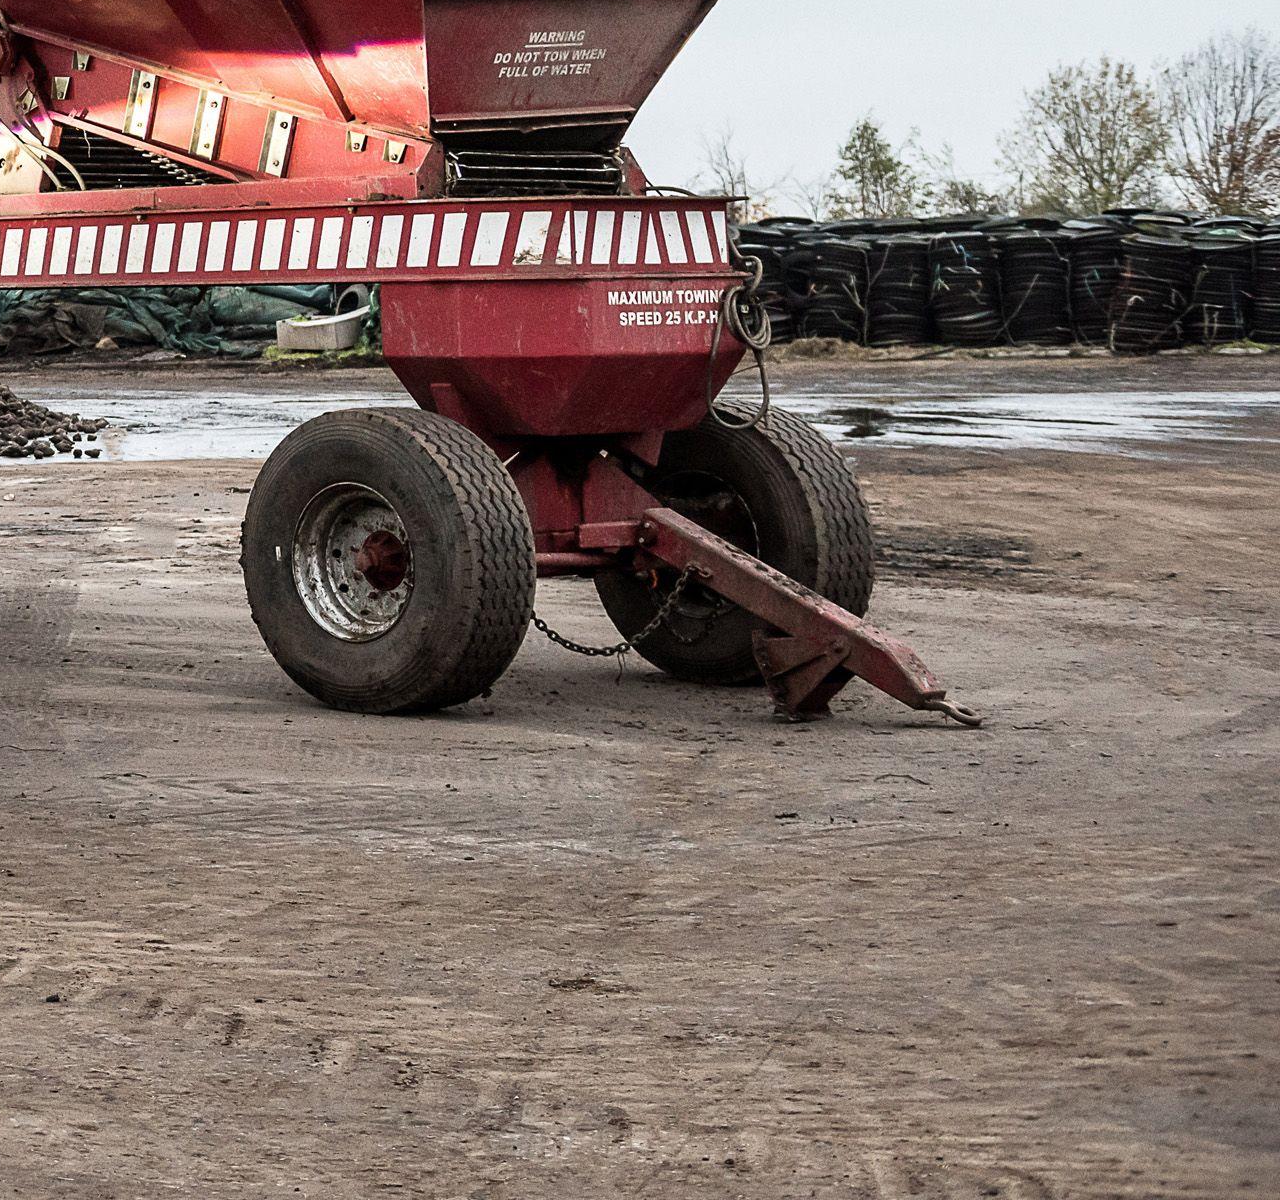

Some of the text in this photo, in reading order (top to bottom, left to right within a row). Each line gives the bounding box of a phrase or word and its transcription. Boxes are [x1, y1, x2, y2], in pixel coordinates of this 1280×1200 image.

[528, 30, 586, 43] WARNING
[493, 48, 607, 64] DO NOT TOW WHEN
[499, 63, 592, 78] FULL OF WATER
[608, 290, 673, 305] MAXIMUM
[619, 311, 663, 326] SPEED
[665, 311, 681, 325] 25
